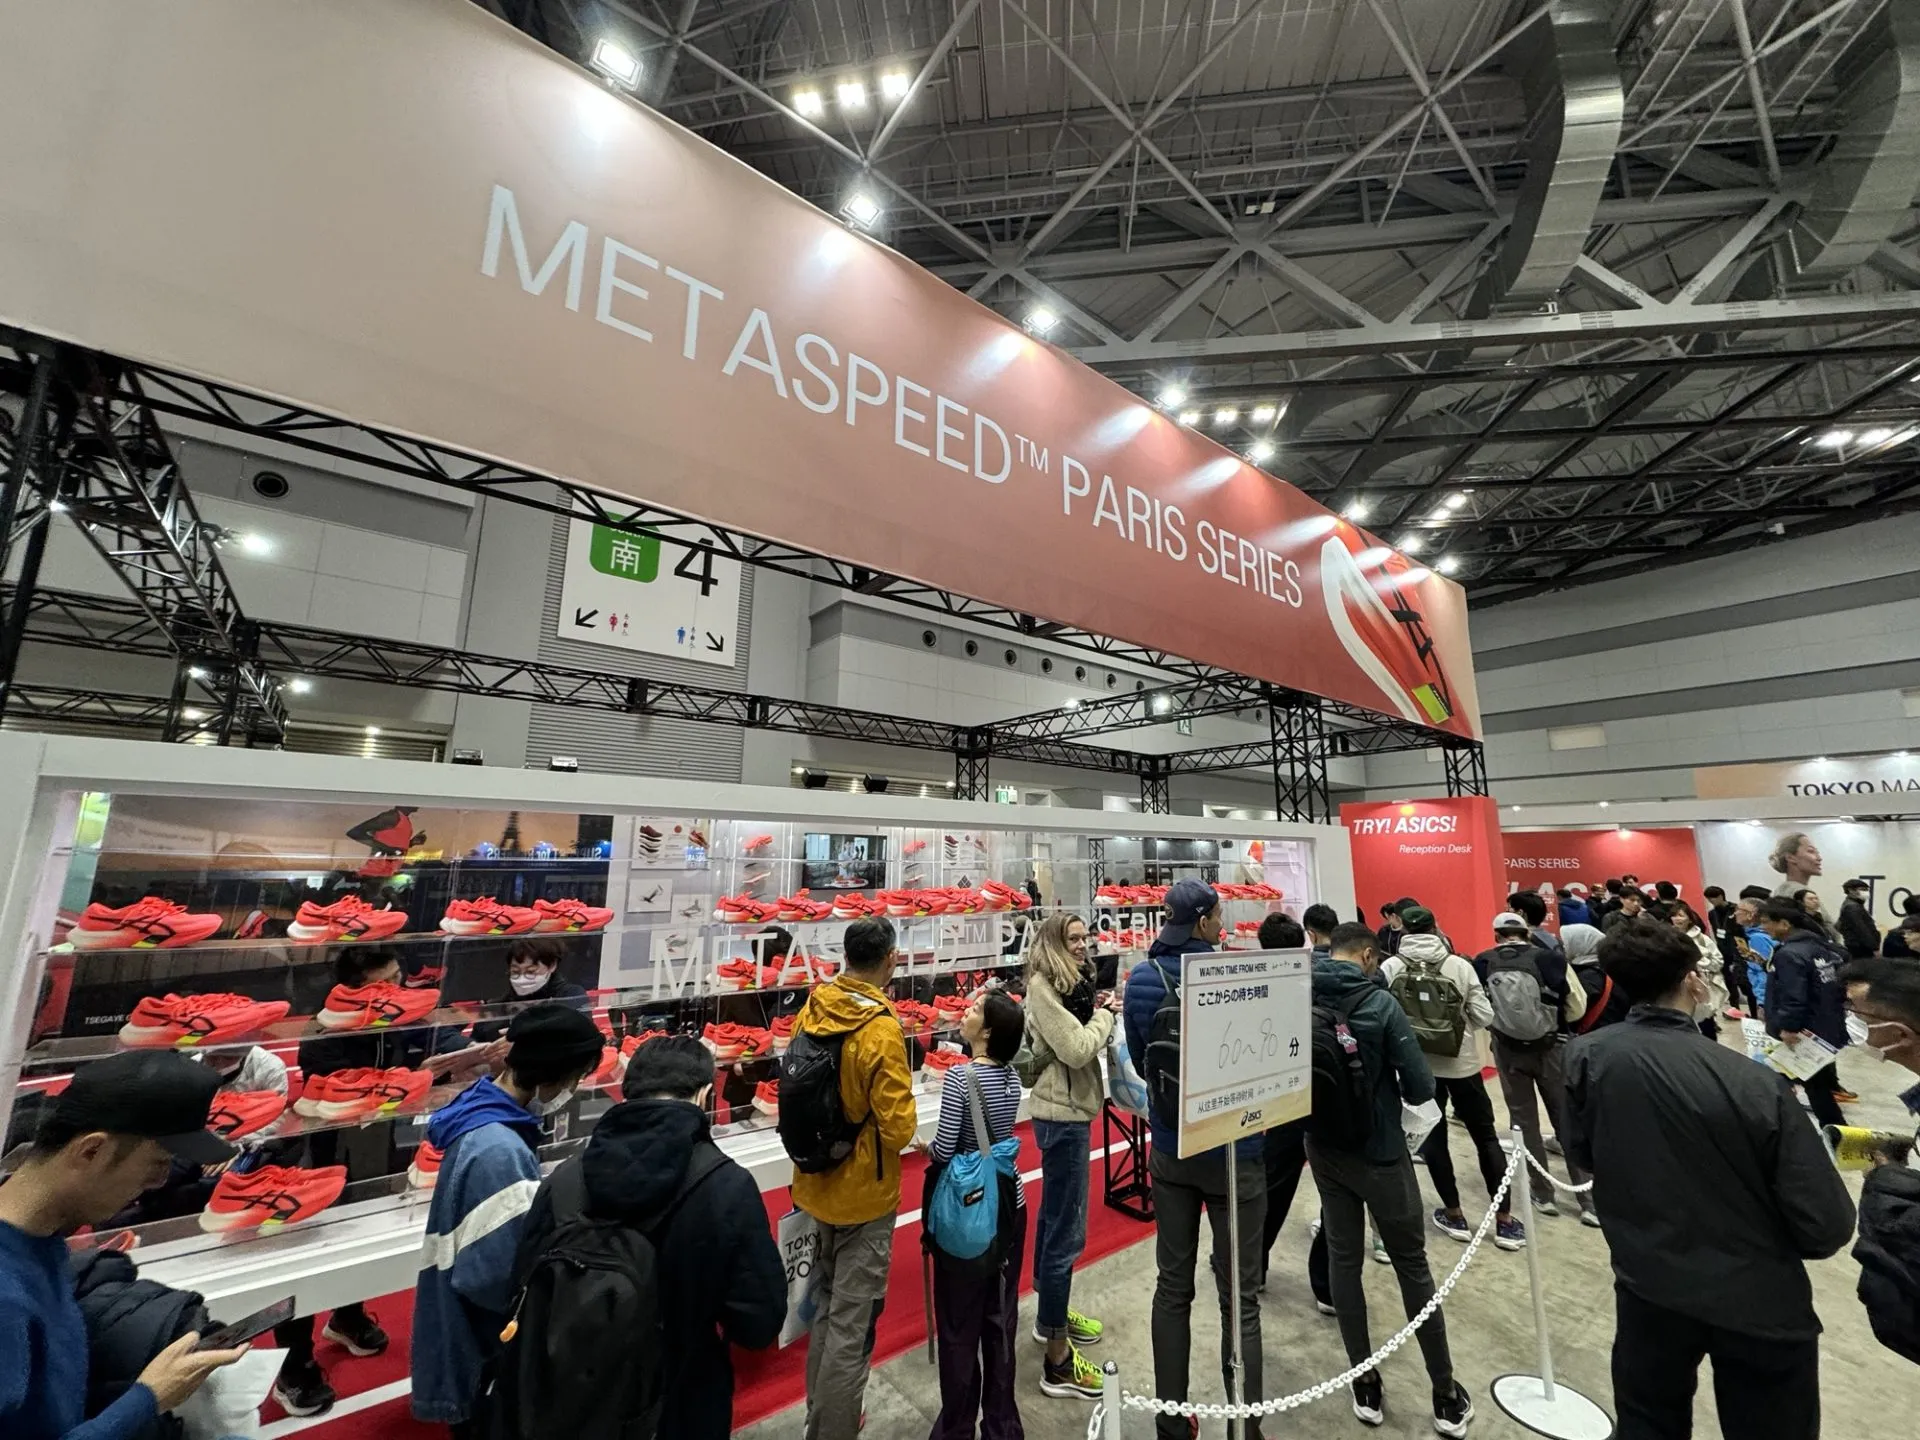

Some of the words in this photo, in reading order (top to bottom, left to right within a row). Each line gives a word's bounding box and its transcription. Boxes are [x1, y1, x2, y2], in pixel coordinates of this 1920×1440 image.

[1062, 455, 1186, 561] PARIS
[1197, 520, 1304, 609] SERIES
[611, 538, 641, 575] 南
[674, 538, 718, 597] 4
[1787, 780, 1875, 797] TOKYO
[1353, 818, 1391, 835] TRY!
[1394, 815, 1457, 834] ASICS!
[1399, 844, 1446, 855] Reception
[1448, 843, 1472, 854] Desk
[1504, 857, 1536, 869] PARIS
[1539, 857, 1580, 869] SERIES
[1199, 966, 1225, 977] WAITING
[1226, 965, 1238, 975] TIME
[1239, 964, 1254, 973] FROM
[1255, 962, 1267, 972] HERE
[1198, 984, 1268, 1007] ここからの待ち時間
[1289, 1036, 1300, 1057] 分
